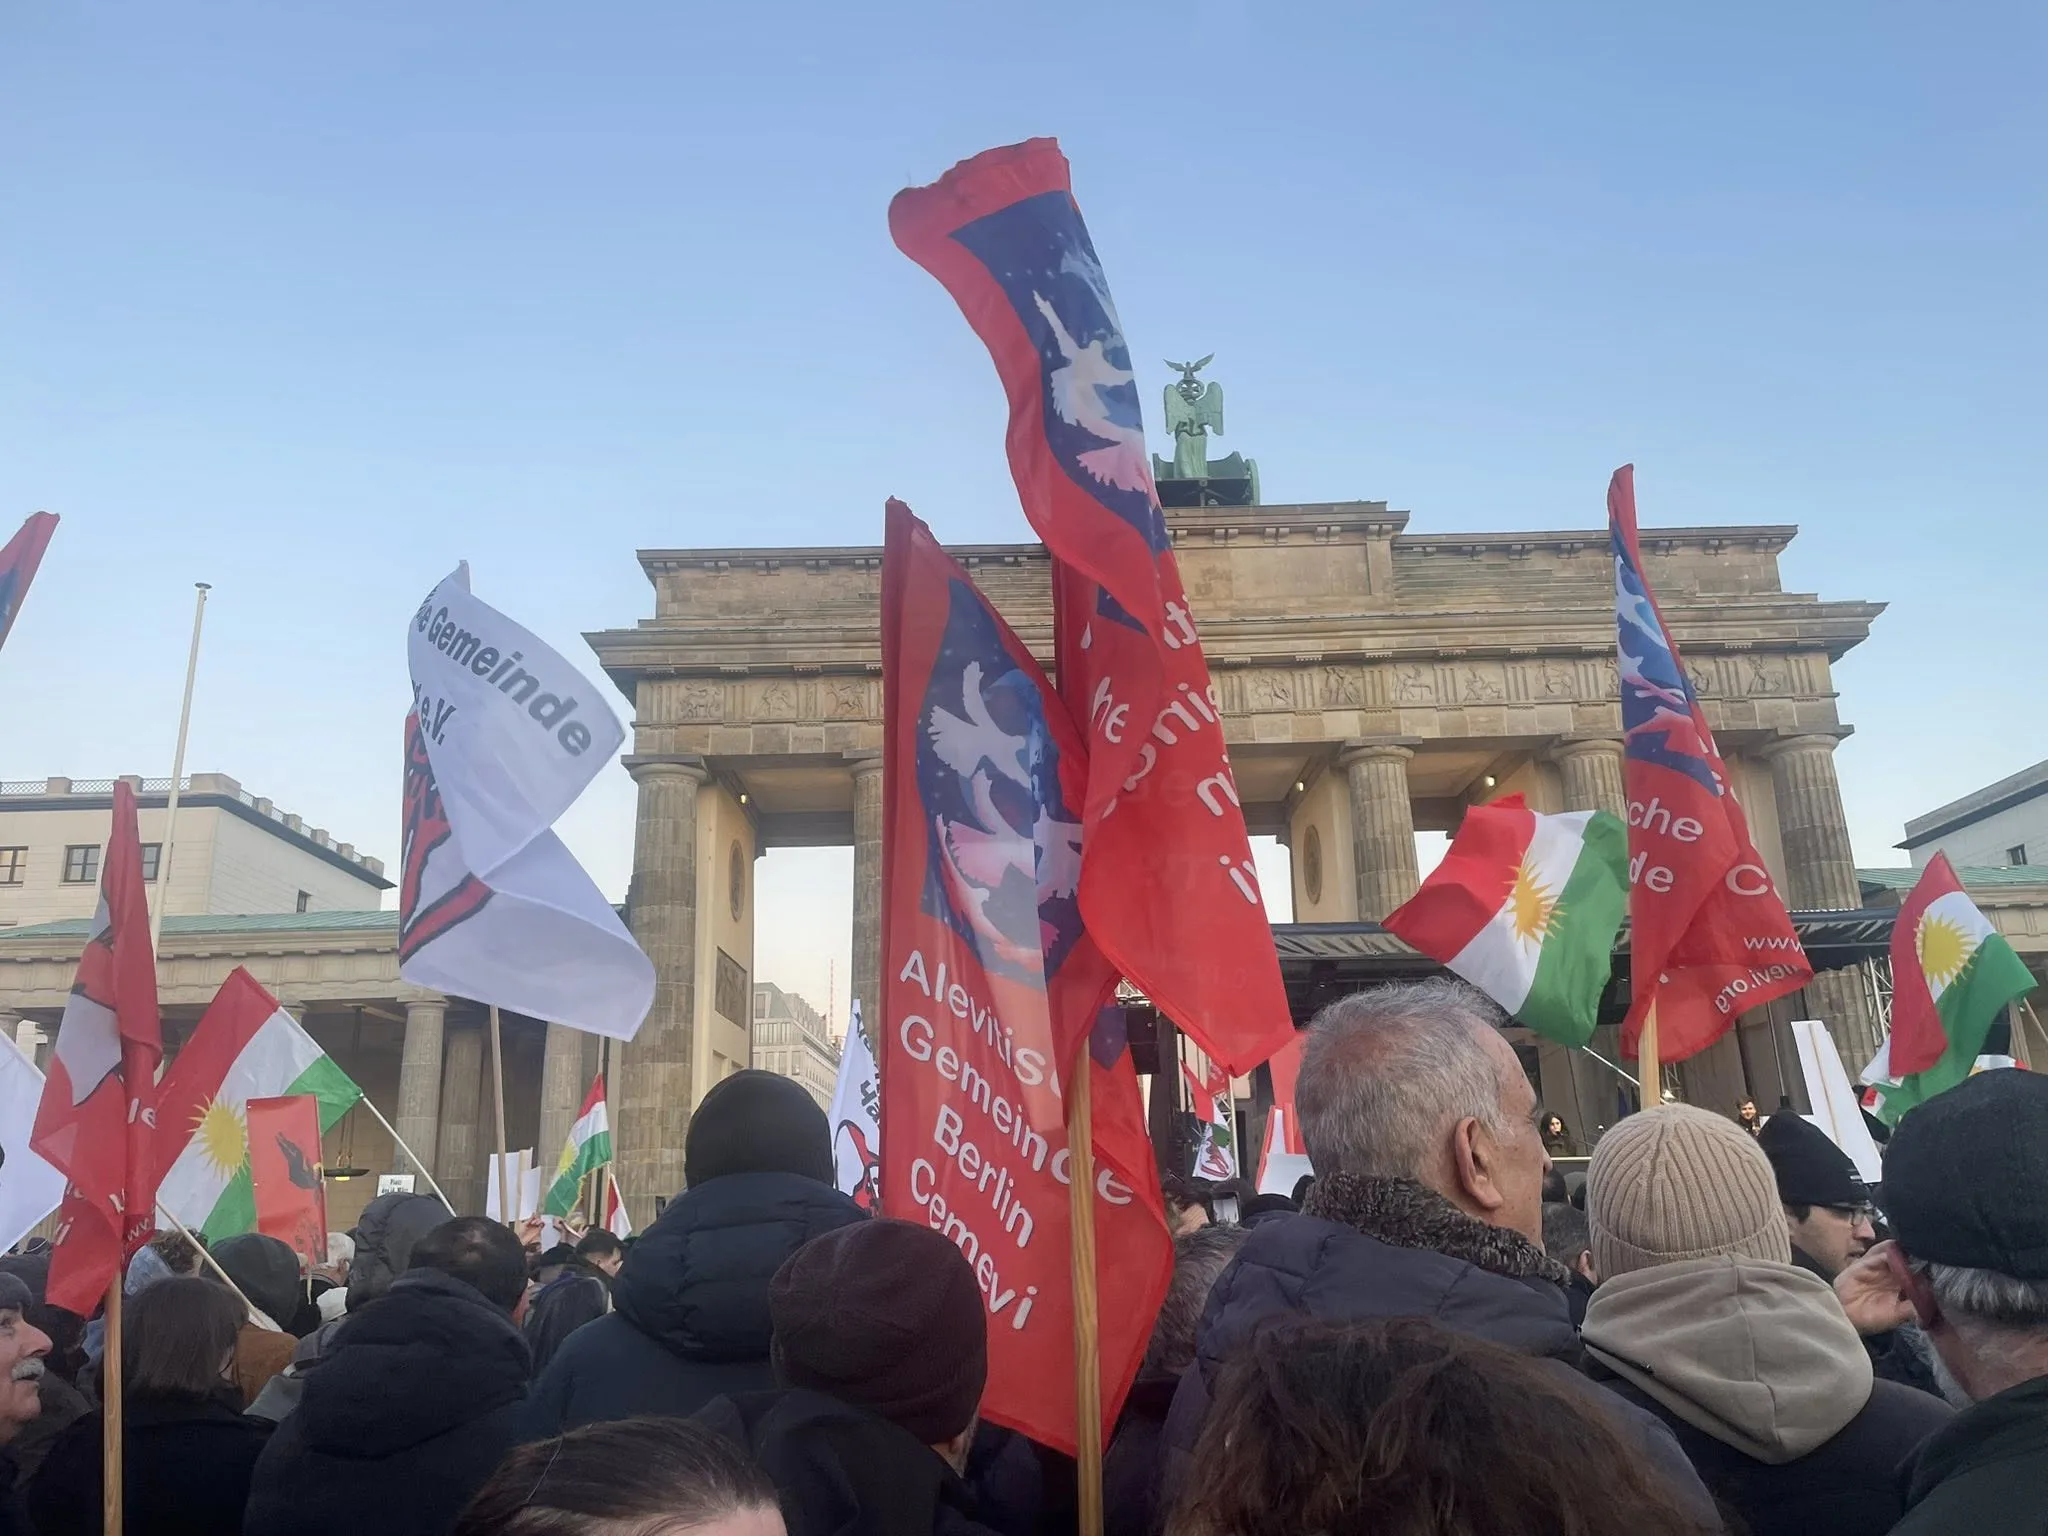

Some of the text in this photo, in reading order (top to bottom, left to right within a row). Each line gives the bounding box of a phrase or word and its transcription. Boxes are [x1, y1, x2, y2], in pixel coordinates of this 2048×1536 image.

[427, 606, 592, 757] Gemeinde
[910, 1158, 1038, 1330] Cemevi
[934, 1104, 1034, 1248] Berlin
